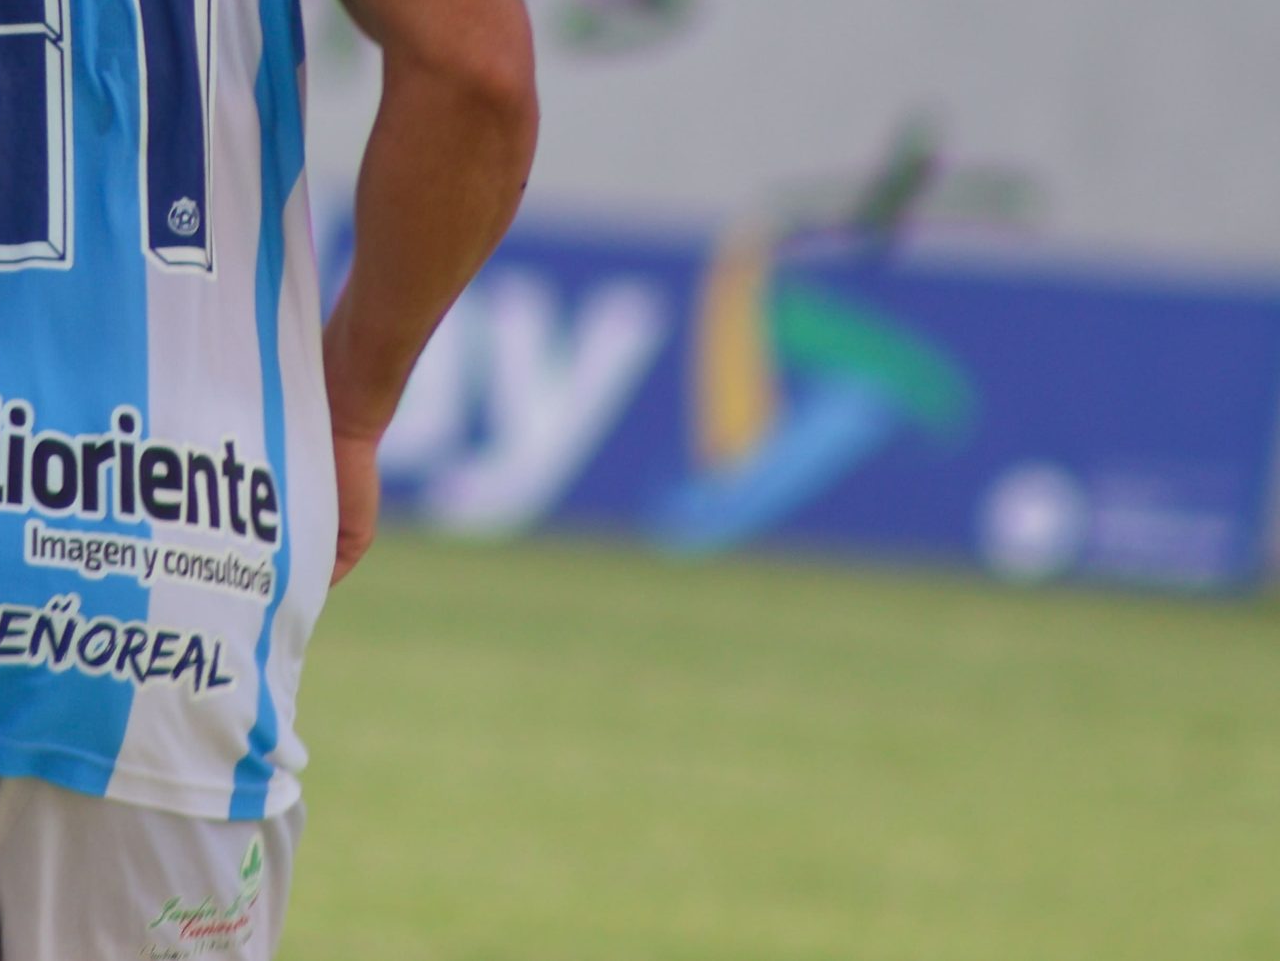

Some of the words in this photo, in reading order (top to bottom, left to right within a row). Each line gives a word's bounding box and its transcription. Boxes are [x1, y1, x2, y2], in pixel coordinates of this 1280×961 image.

[32, 527, 136, 571] Imagen
[143, 545, 159, 580] y
[164, 549, 272, 596] consultoría
